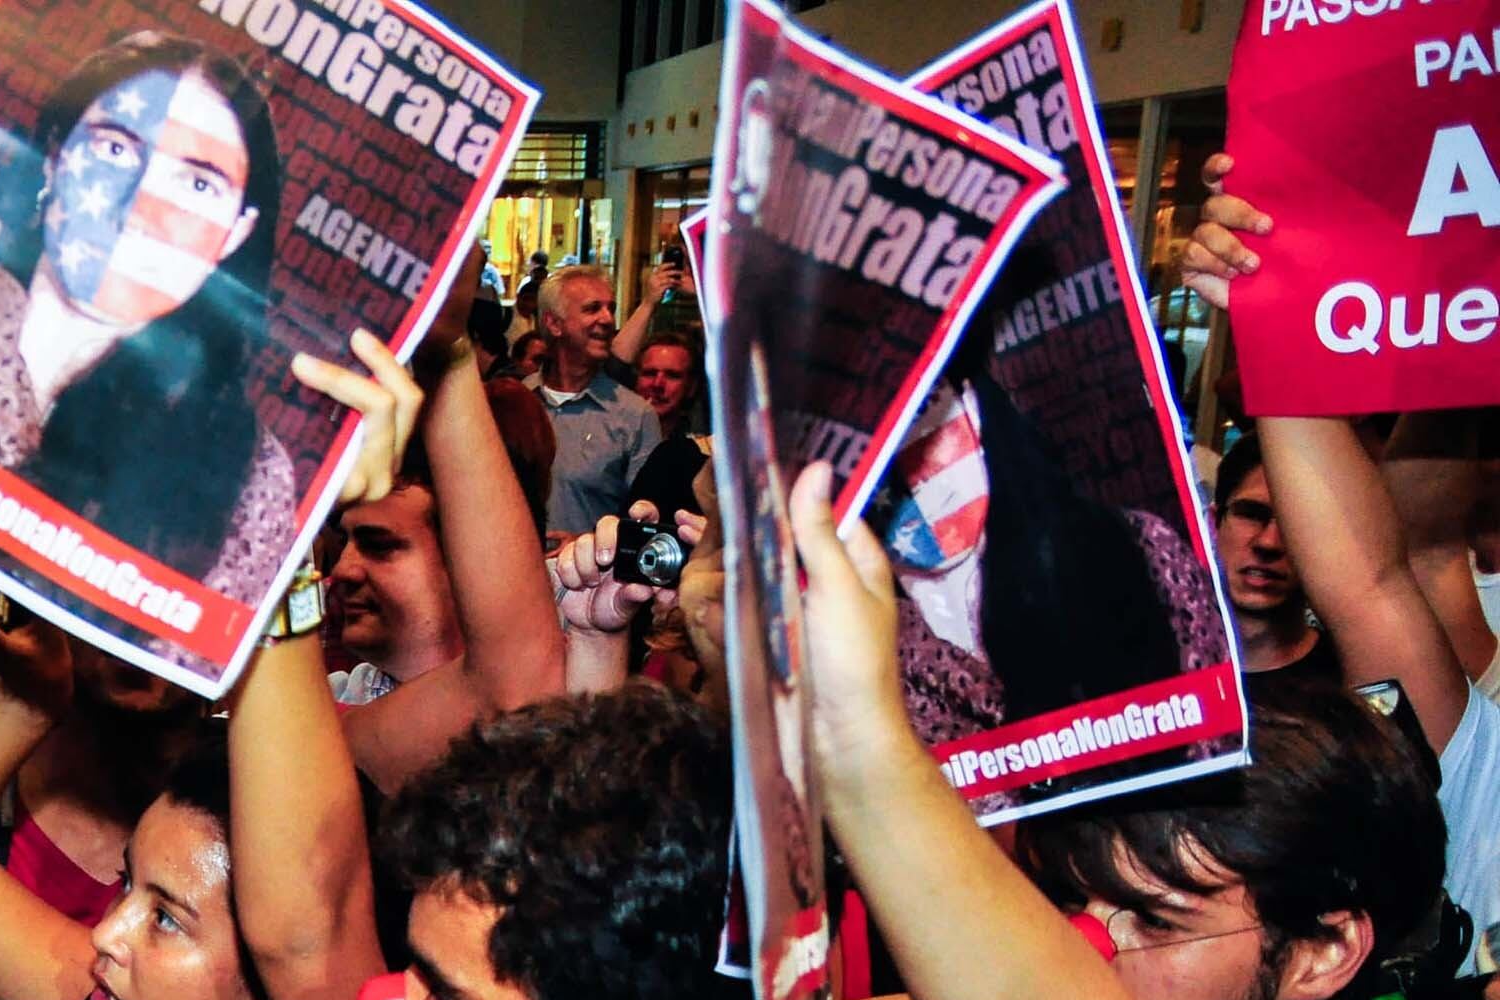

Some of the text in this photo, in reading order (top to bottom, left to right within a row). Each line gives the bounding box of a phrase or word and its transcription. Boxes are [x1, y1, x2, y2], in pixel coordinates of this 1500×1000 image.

[1414, 27, 1500, 88] PA
[295, 193, 432, 302] AGENTE
[993, 258, 1122, 354] AGENTE
[1315, 281, 1500, 356] Que
